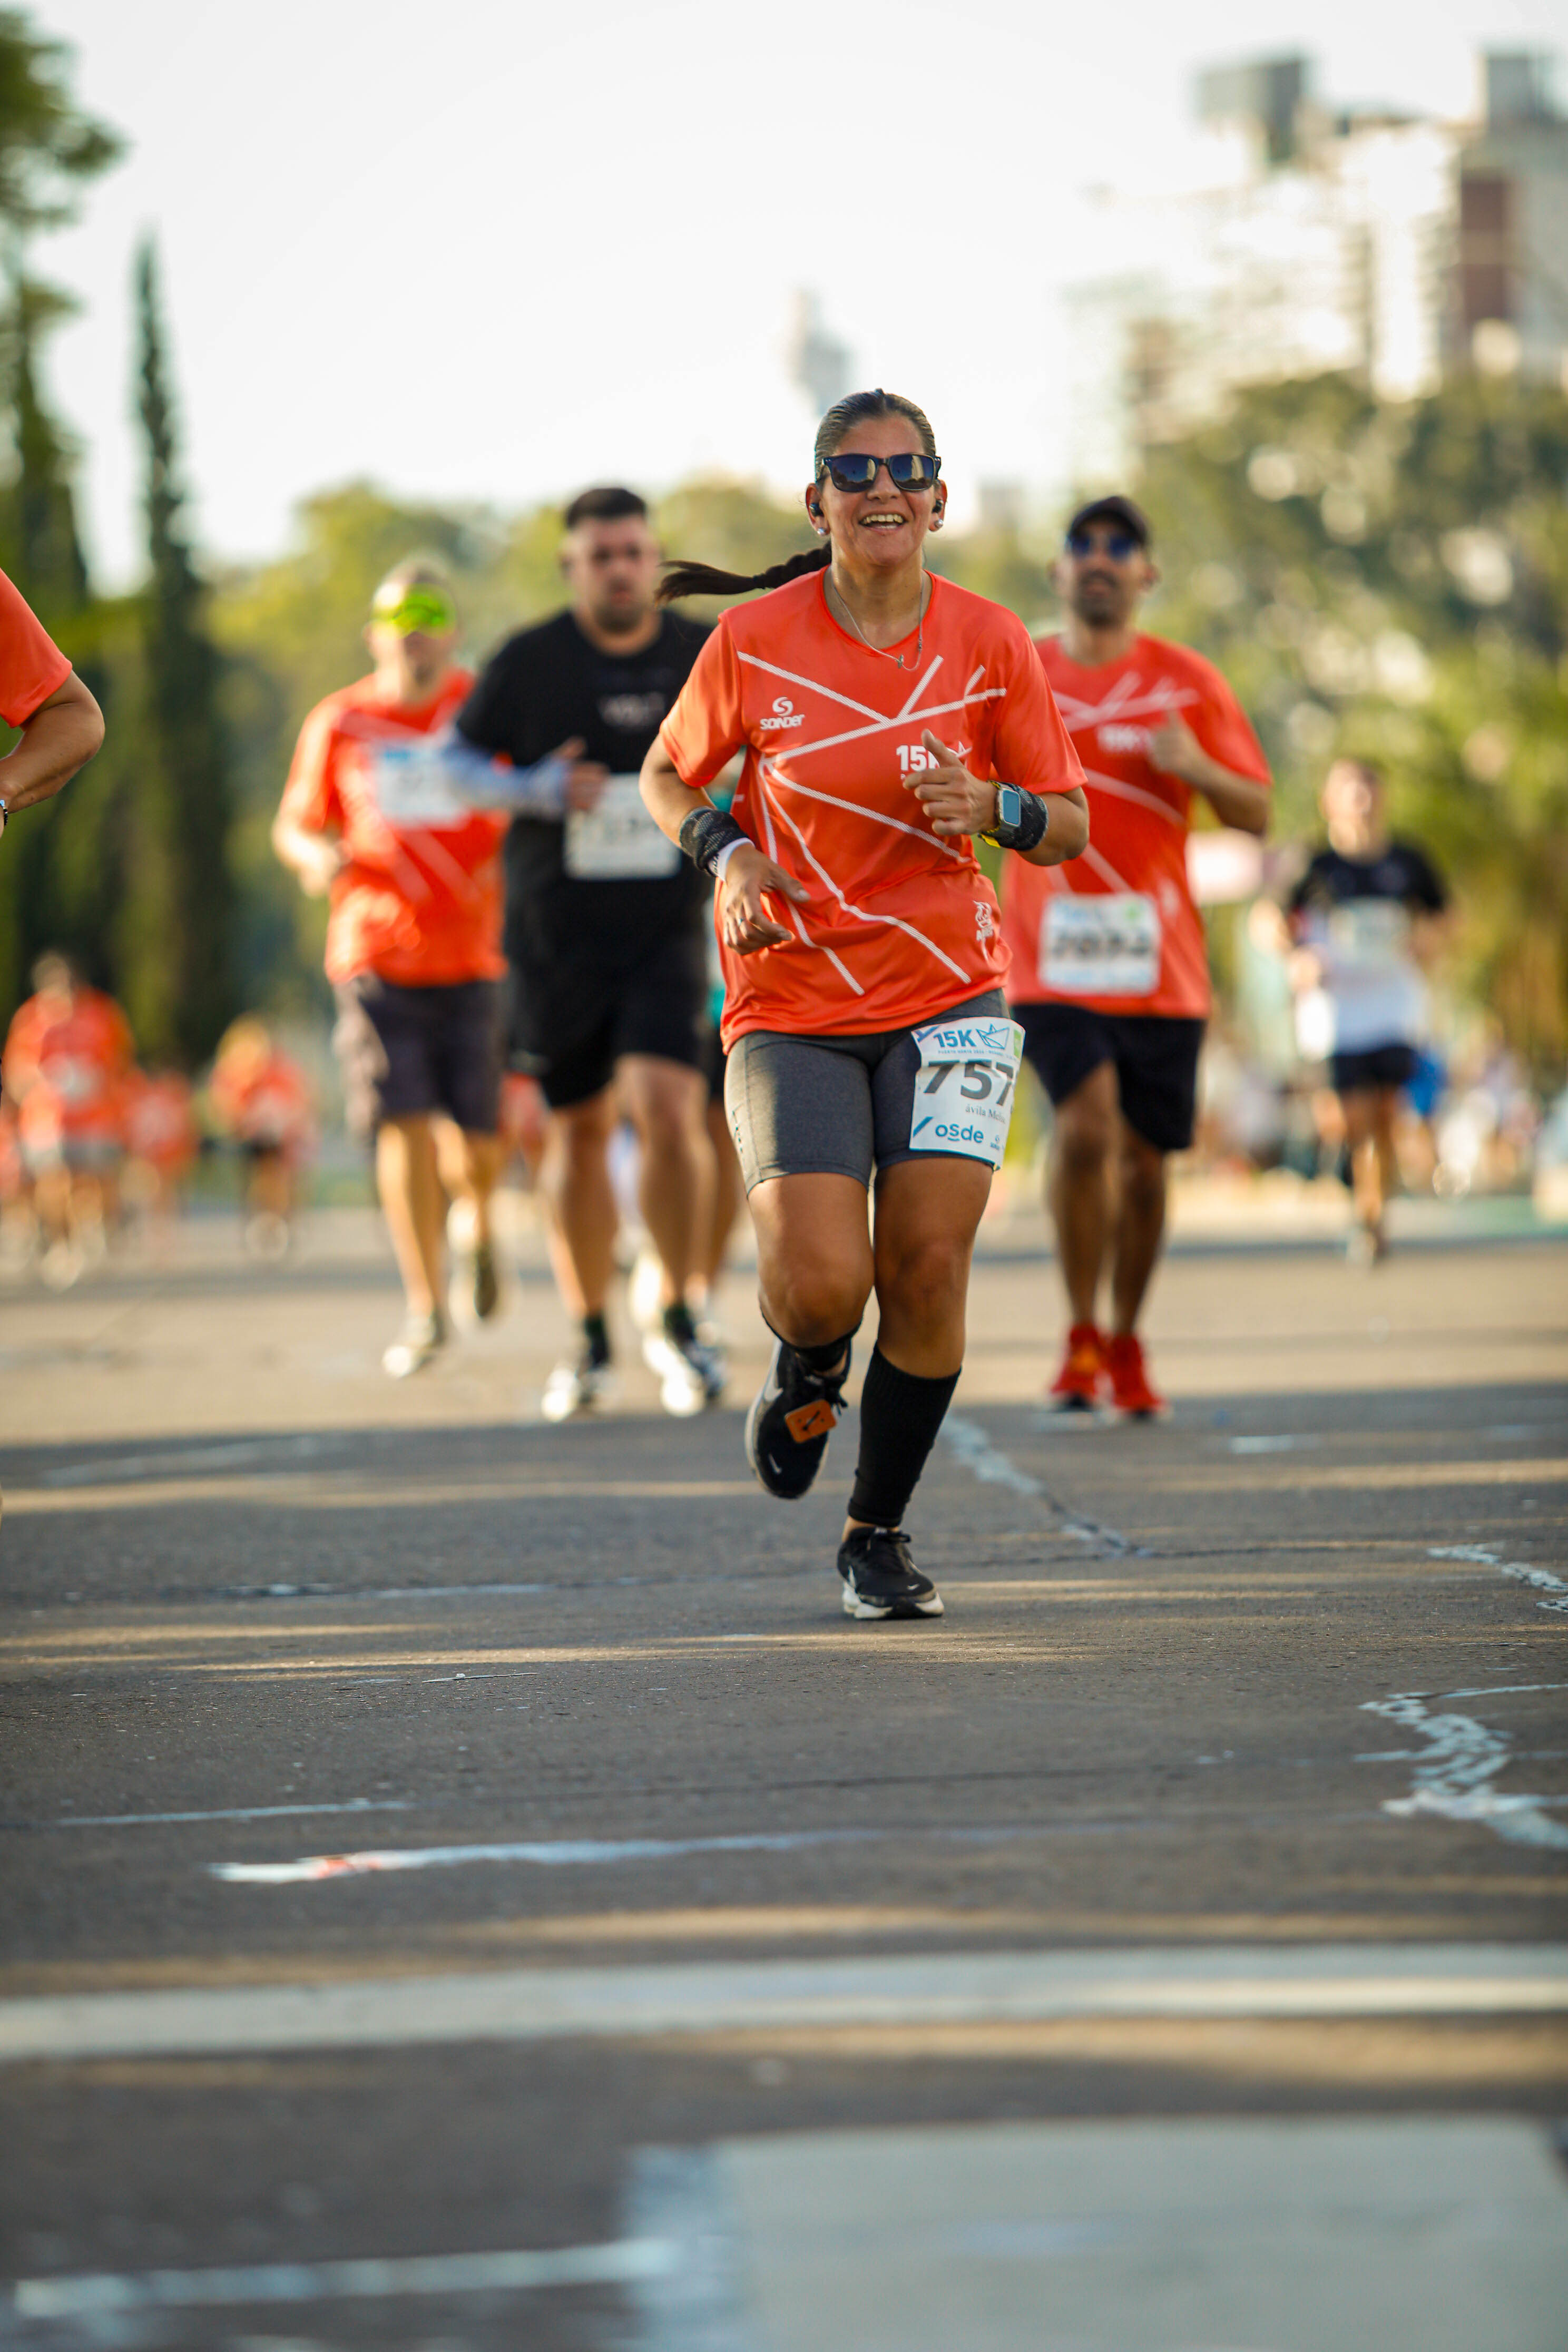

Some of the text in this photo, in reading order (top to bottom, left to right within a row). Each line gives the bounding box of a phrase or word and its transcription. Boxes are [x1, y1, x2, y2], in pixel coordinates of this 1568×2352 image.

[934, 1030, 976, 1047] 15K
[923, 1059, 1014, 1106] 757
[935, 1123, 984, 1143] osde
